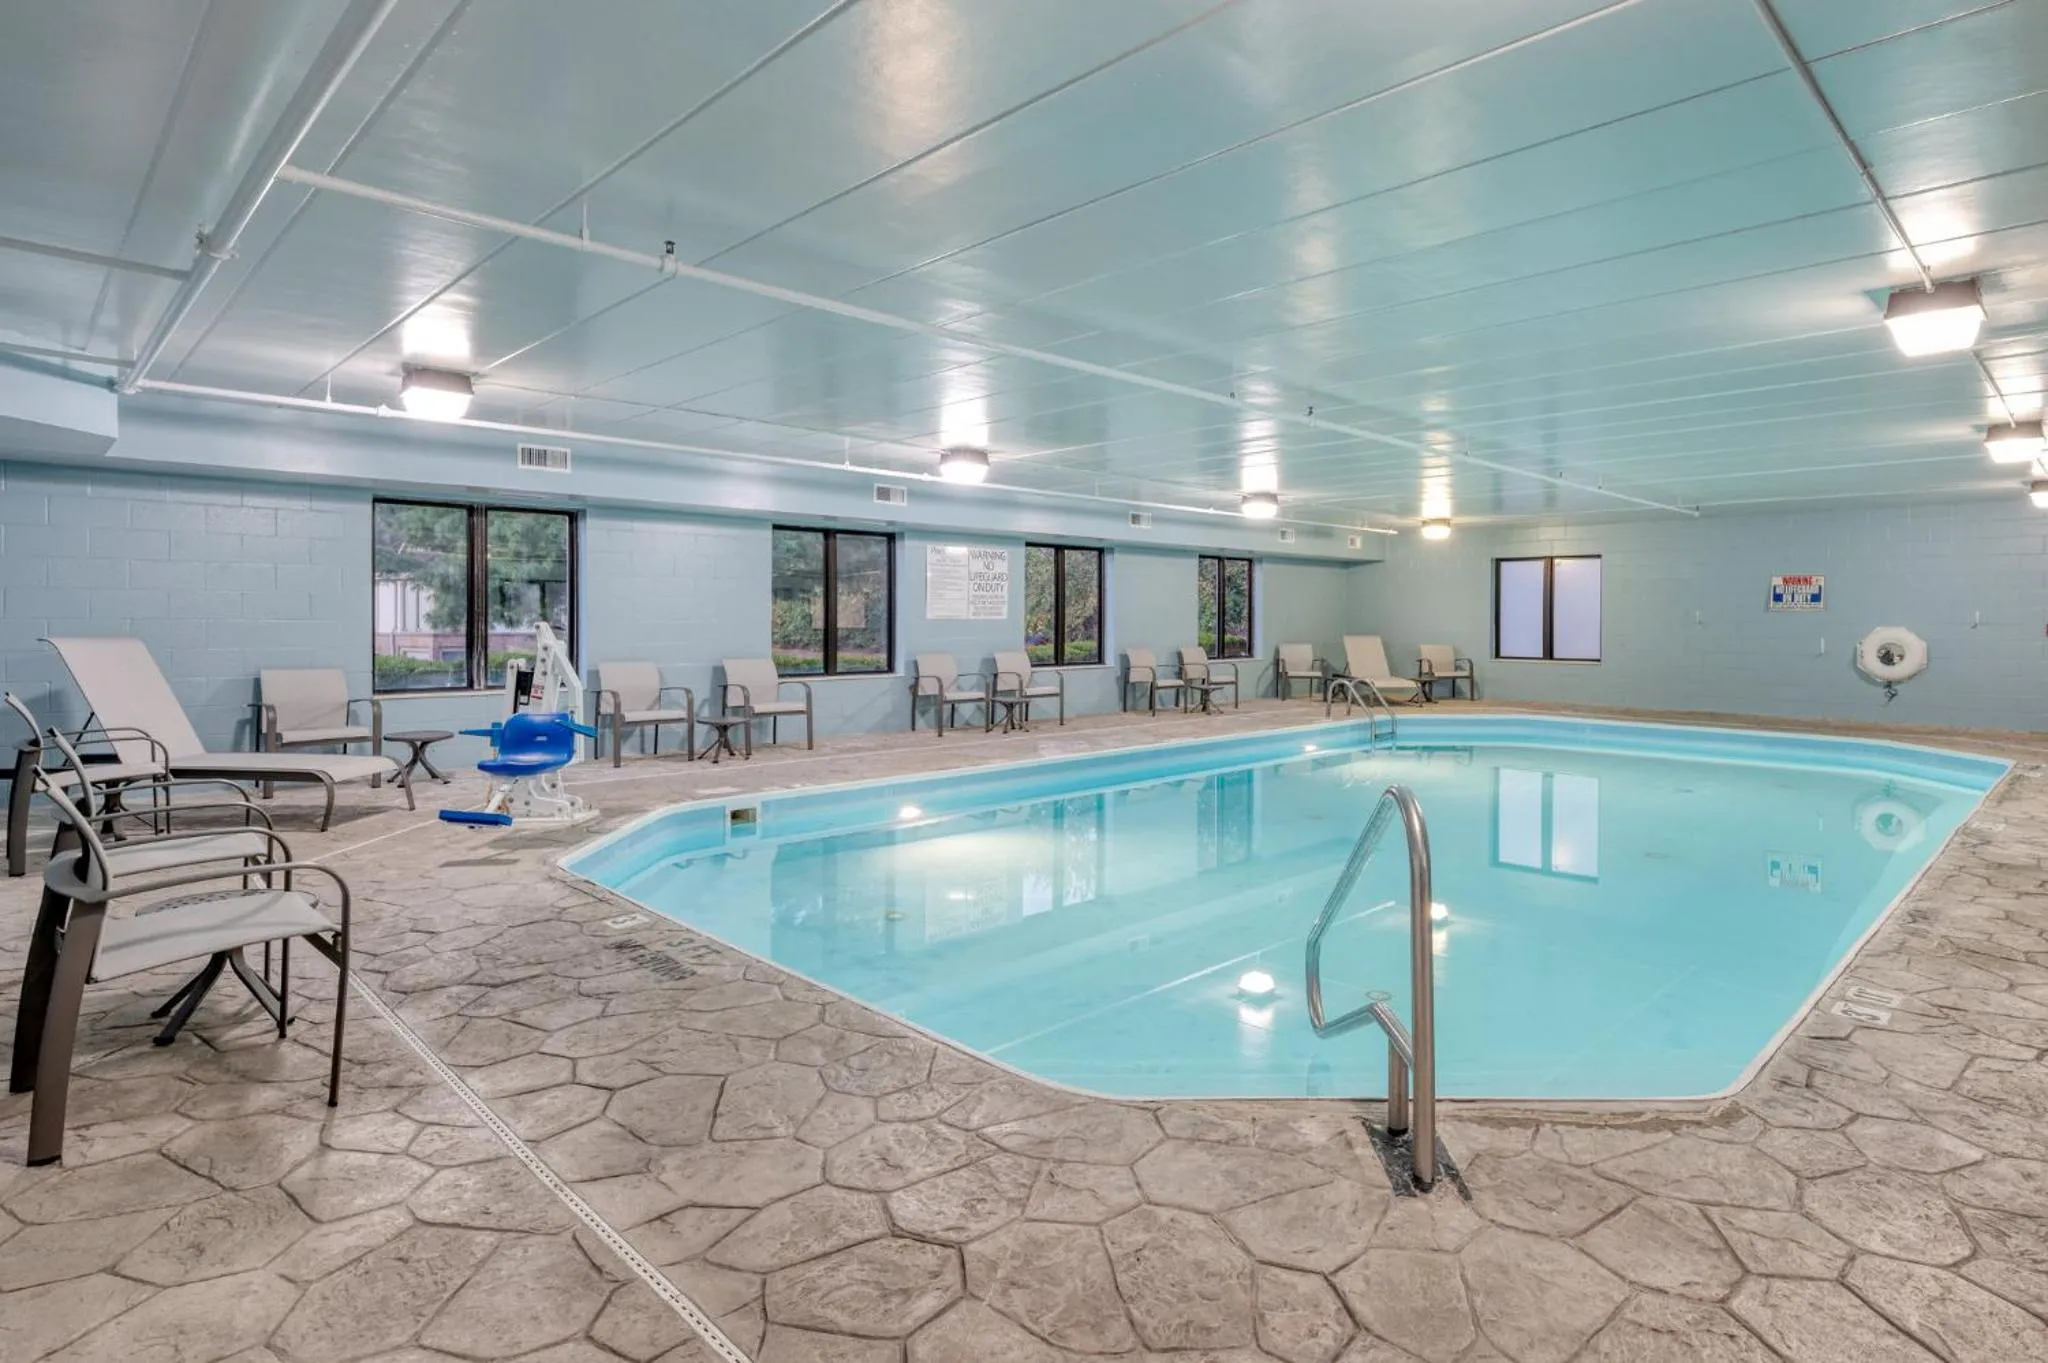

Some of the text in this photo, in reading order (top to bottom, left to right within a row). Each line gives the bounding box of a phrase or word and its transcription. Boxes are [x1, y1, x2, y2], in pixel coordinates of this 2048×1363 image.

[970, 550, 1006, 560] WARNING
[983, 560, 995, 571] NO
[969, 571, 1009, 582] LIFEGUARD
[985, 582, 1004, 593] DUTY
